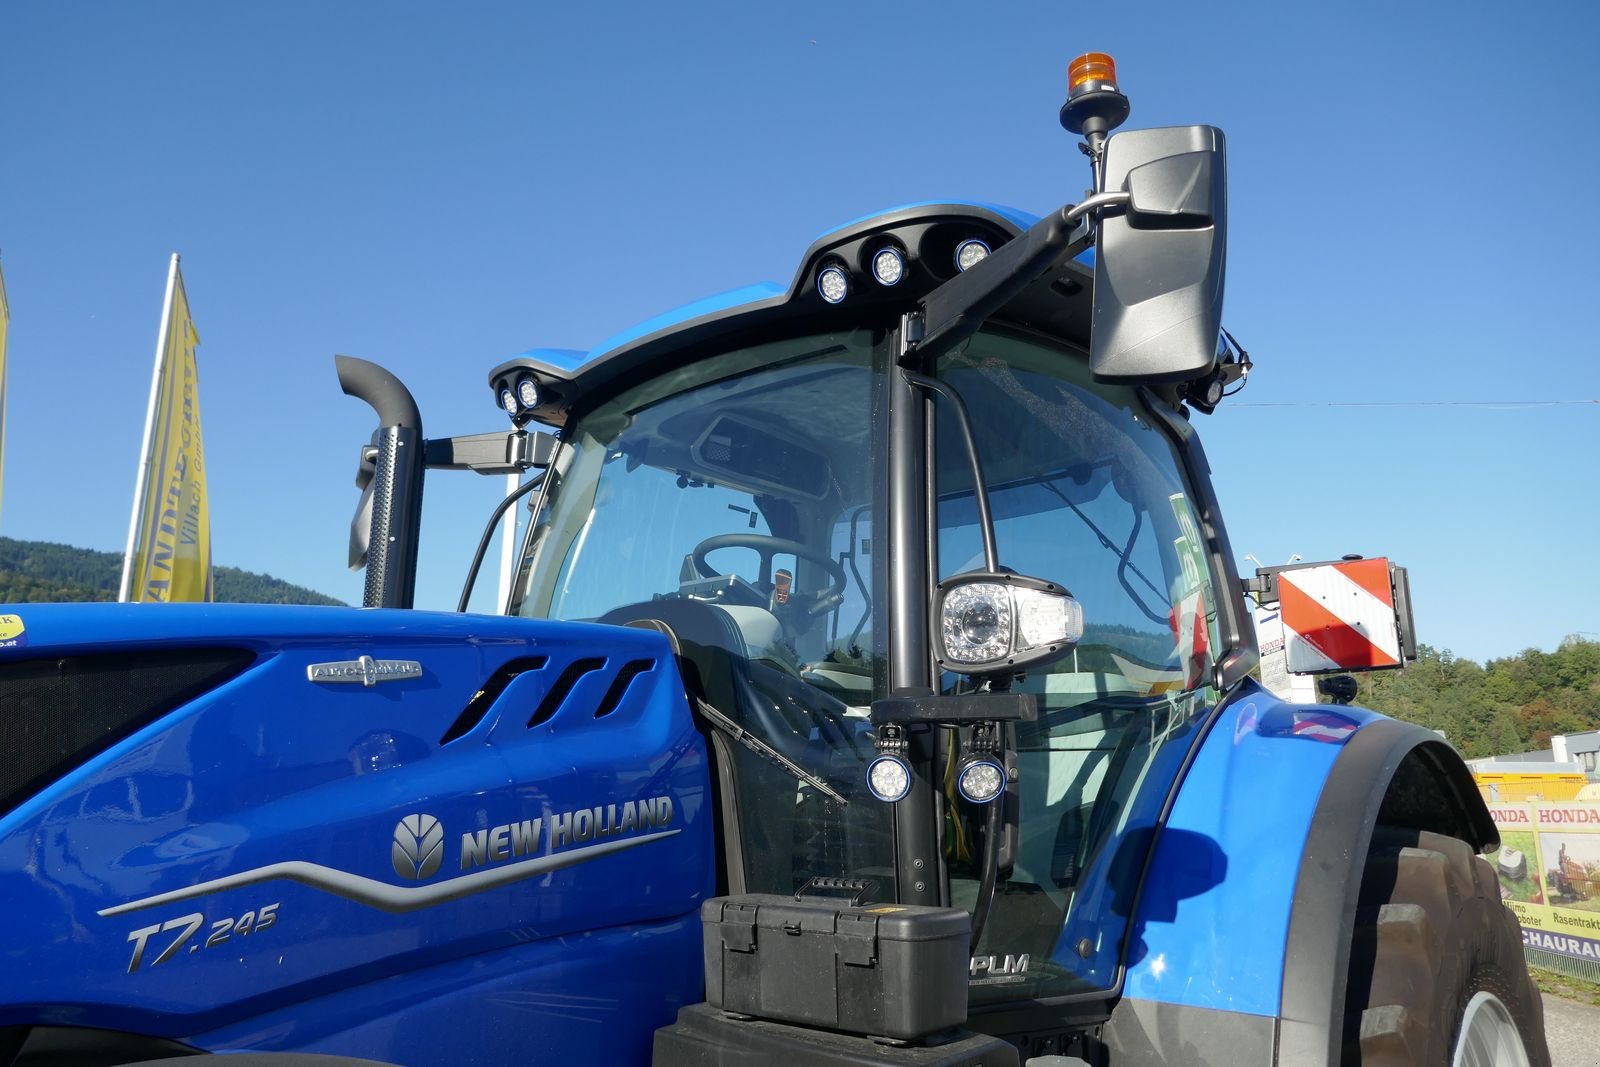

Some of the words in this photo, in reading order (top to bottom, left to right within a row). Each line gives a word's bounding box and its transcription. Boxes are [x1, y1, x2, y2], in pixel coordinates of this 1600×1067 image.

[180, 481, 201, 545] Villach
[1260, 637, 1284, 652] HONDA
[1489, 809, 1529, 823] ONDA
[1538, 808, 1600, 824] HONDA
[461, 817, 543, 870] NEW
[551, 796, 673, 849] HOLLAND
[1517, 914, 1542, 927] oboter
[1522, 930, 1600, 959] CHAURA
[969, 953, 1030, 976] PLM
